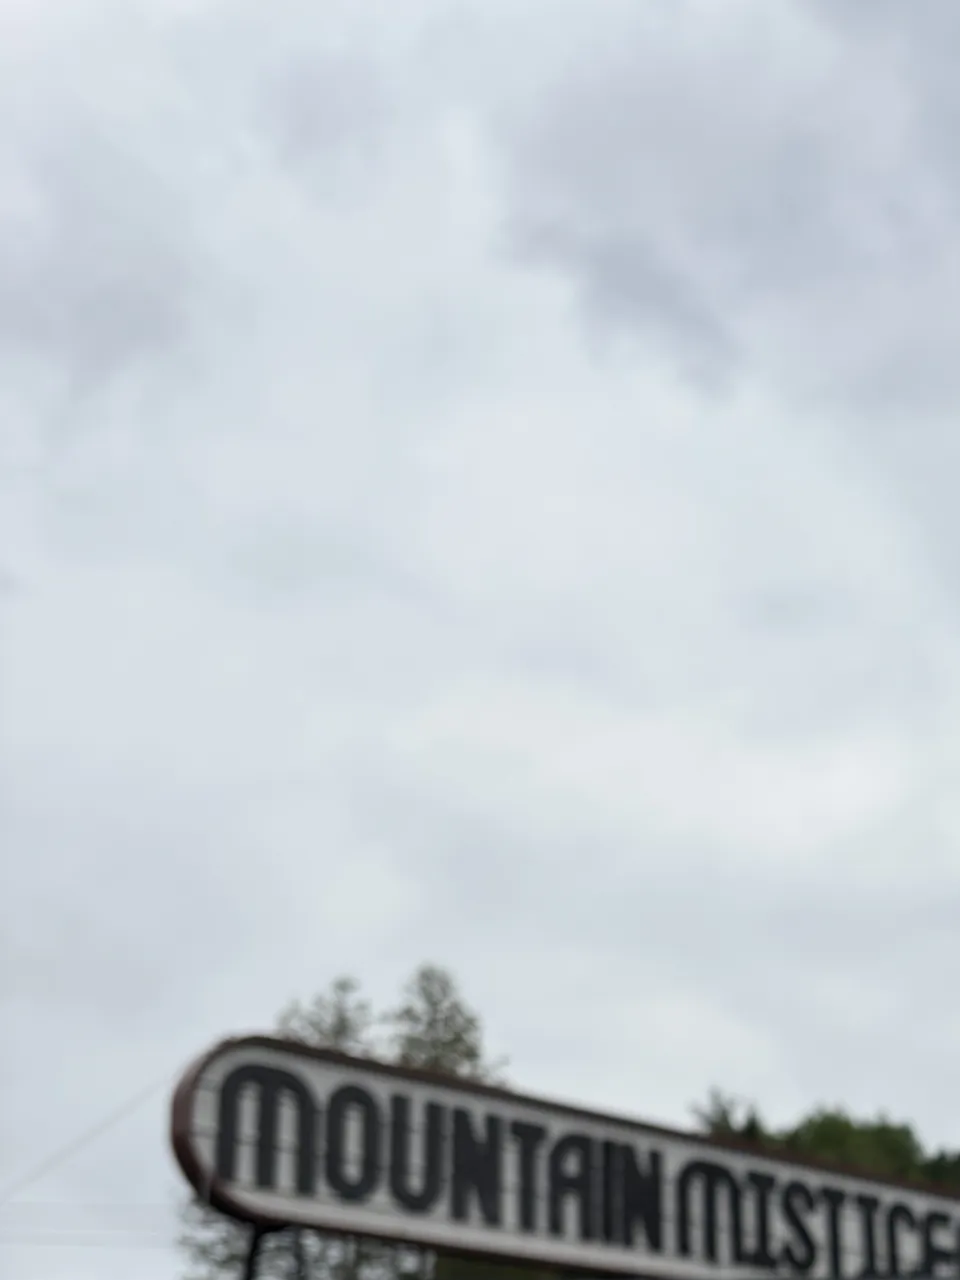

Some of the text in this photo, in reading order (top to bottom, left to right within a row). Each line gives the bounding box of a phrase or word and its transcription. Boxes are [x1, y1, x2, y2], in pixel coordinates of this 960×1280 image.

[215, 1064, 664, 1256] MOUNTAIN
[677, 1160, 846, 1279] MIST
[857, 1195, 958, 1278] ICE
